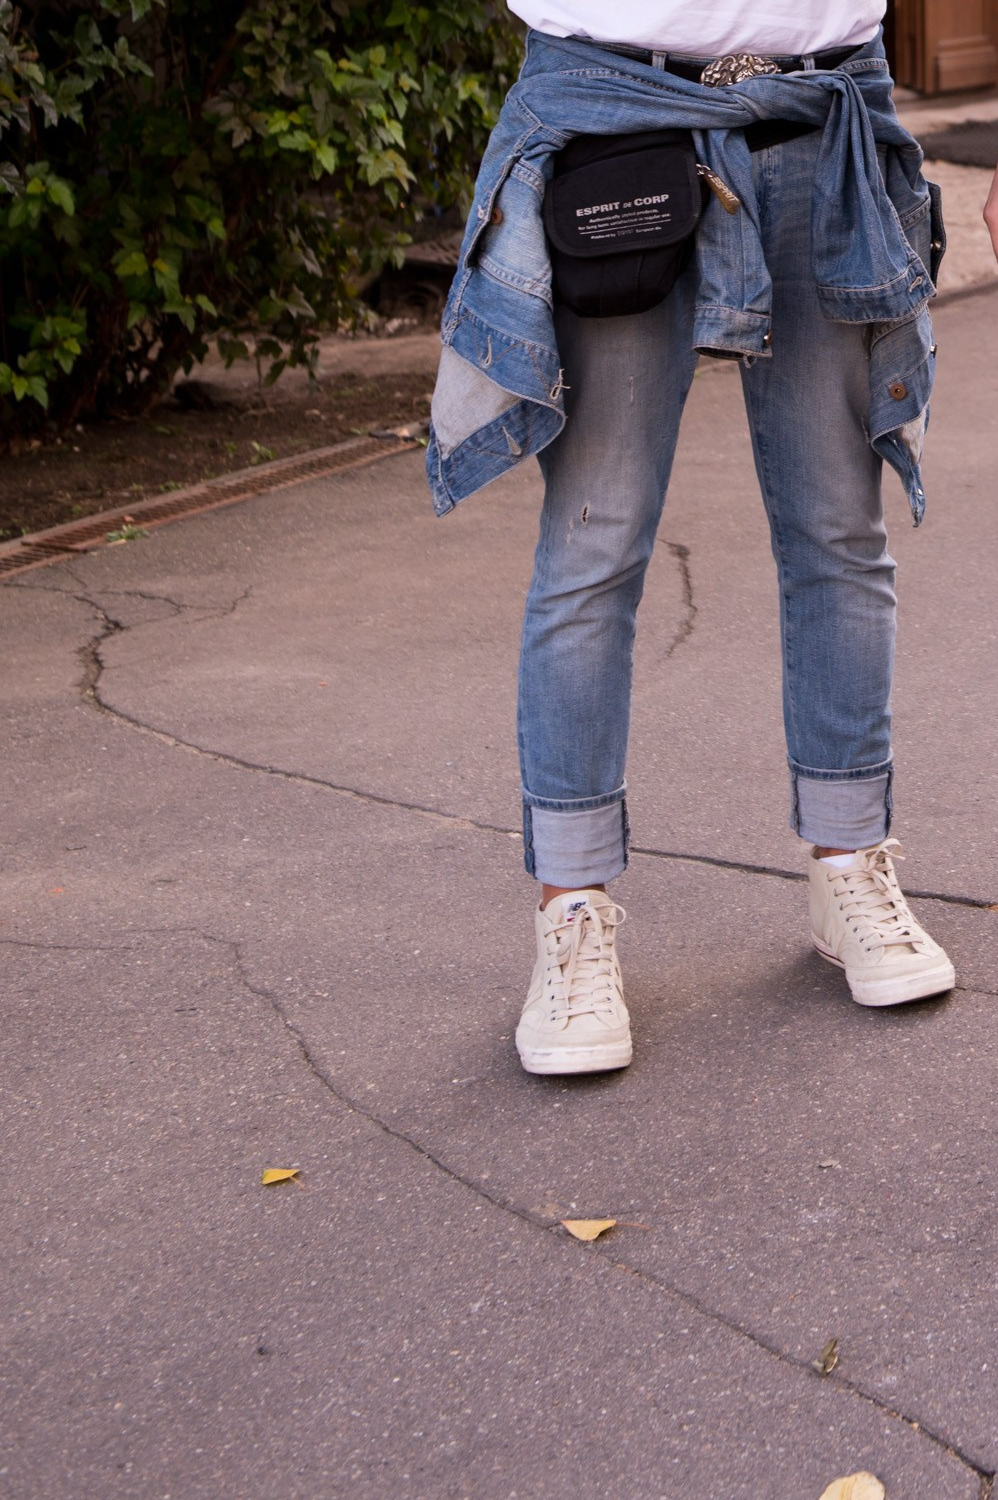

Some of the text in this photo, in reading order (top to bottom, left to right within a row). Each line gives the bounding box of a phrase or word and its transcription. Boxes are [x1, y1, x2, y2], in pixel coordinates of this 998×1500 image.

[711, 176, 740, 202] ESPRIT
[576, 193, 670, 217] ESPRIT DE CORP
